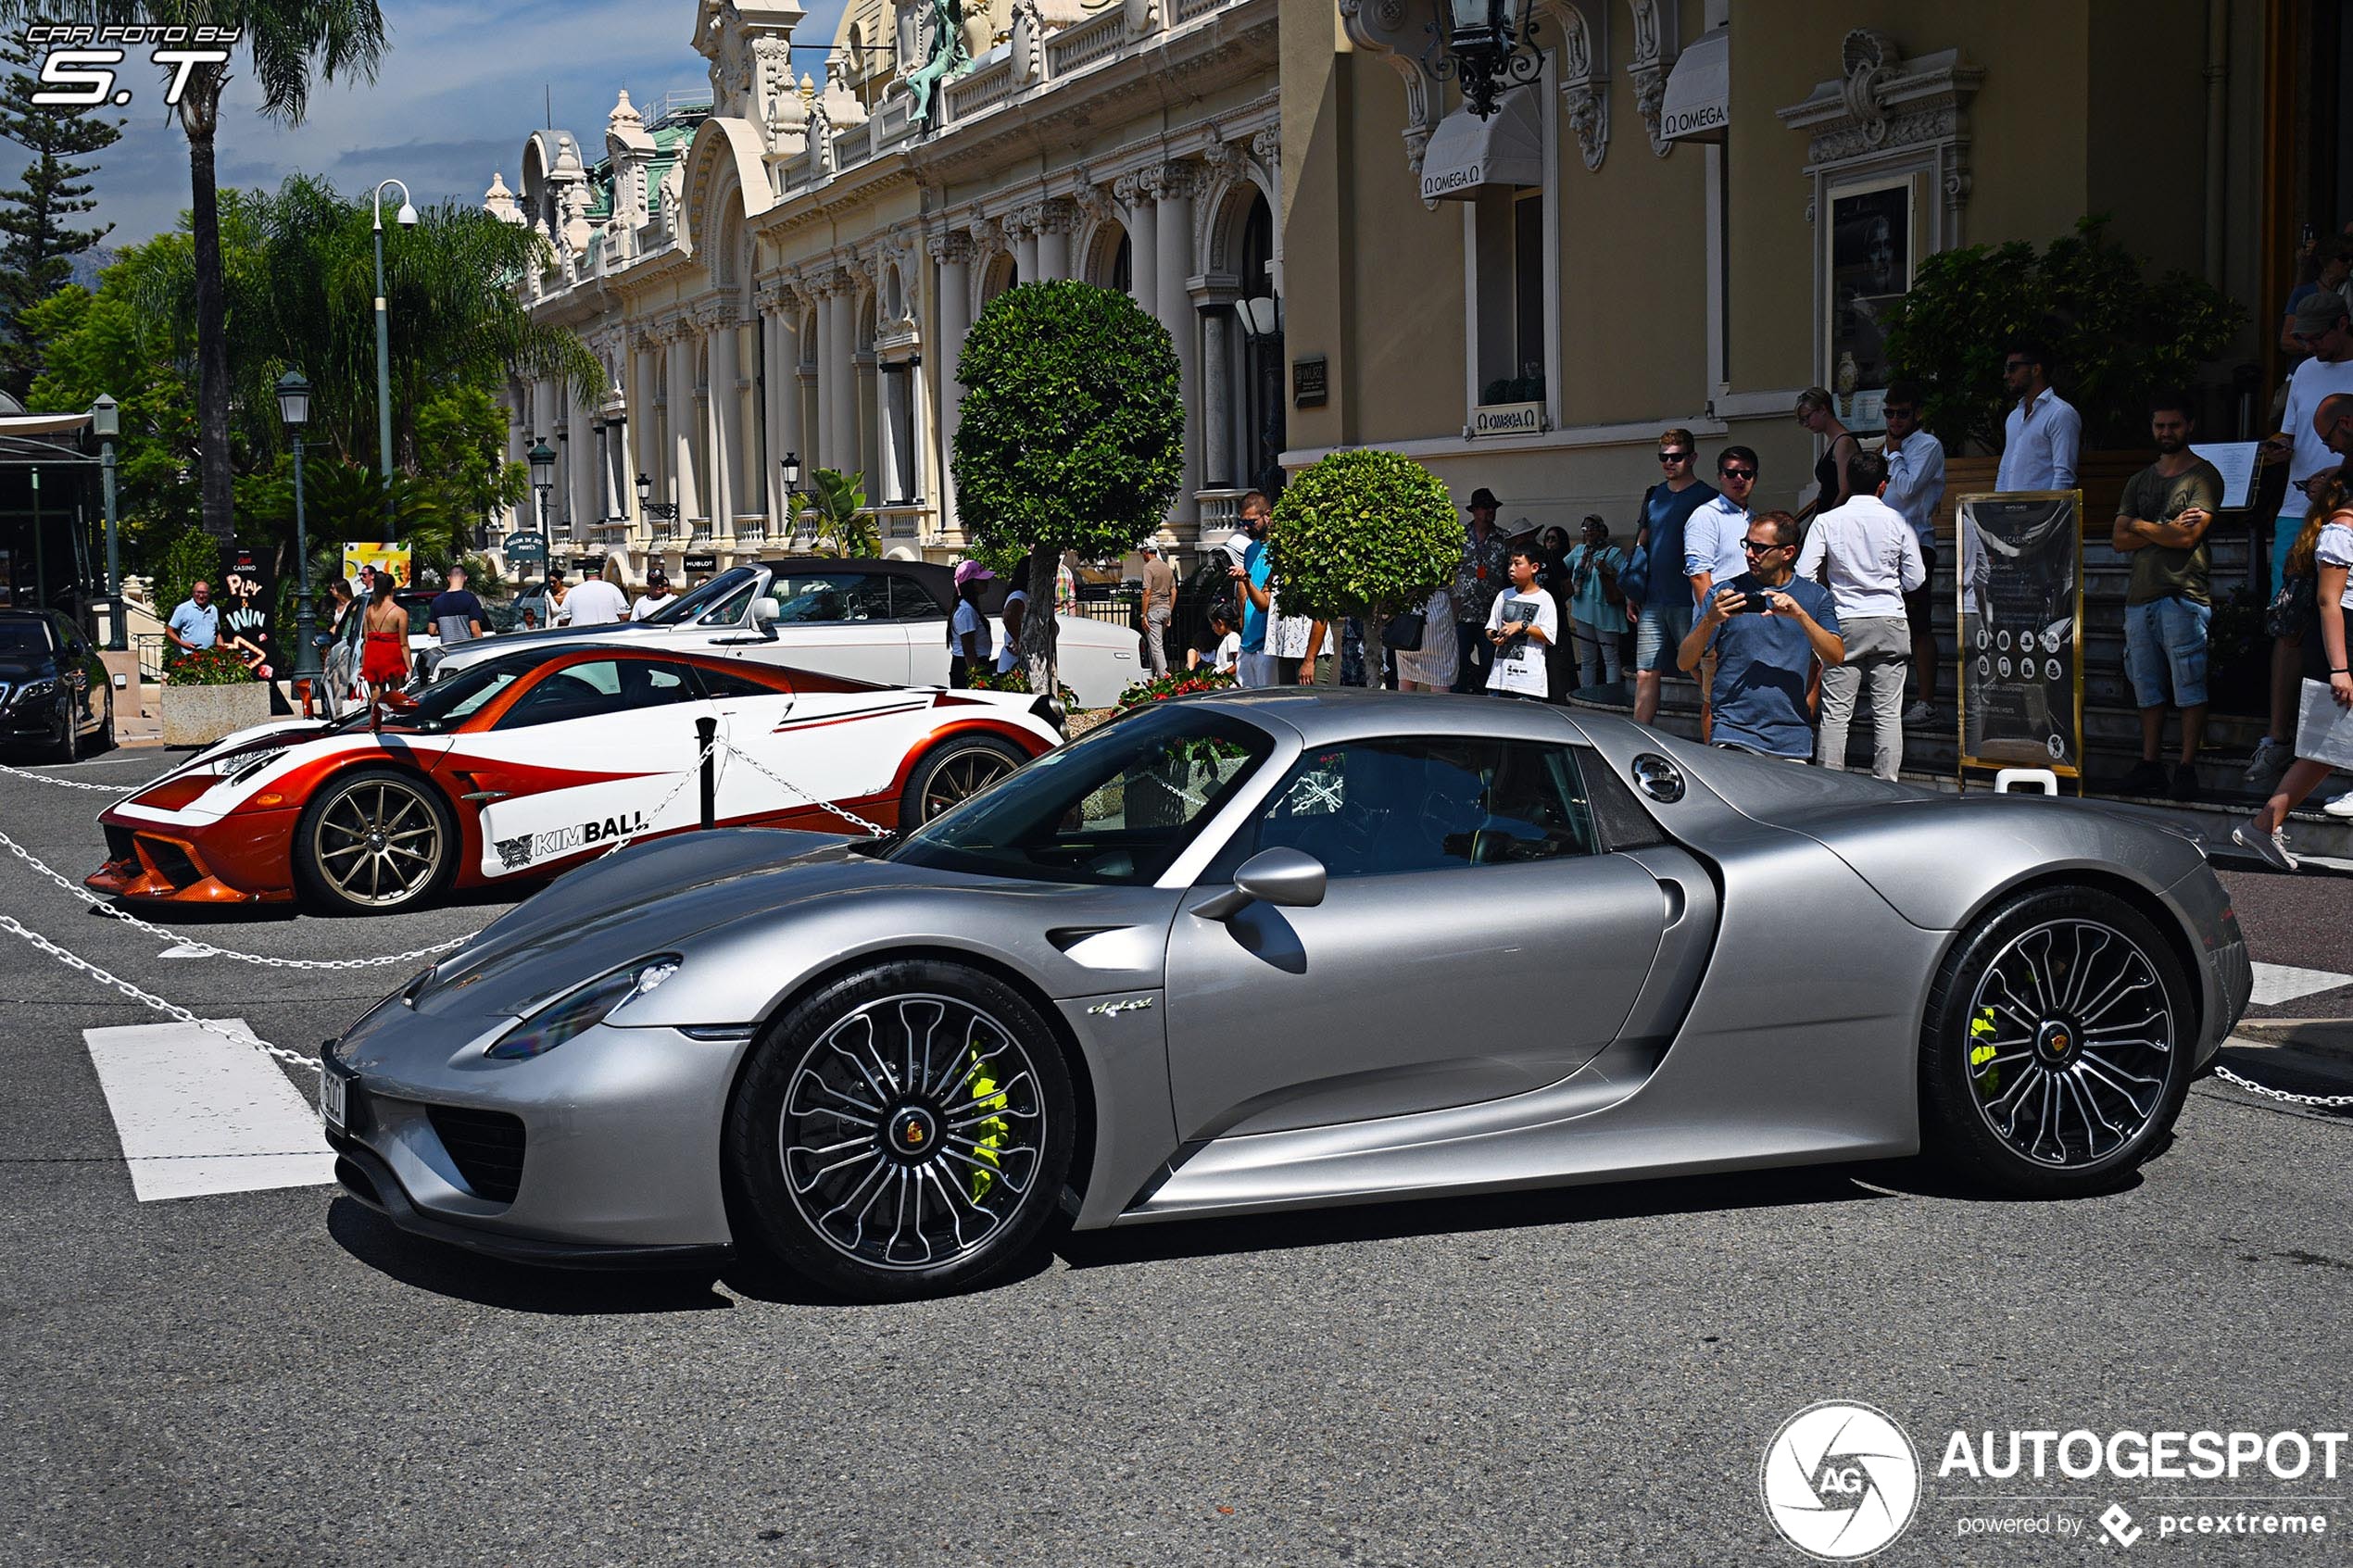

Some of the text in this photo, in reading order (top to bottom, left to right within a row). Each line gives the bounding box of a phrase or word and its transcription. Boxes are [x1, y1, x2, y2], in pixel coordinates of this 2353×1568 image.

[1679, 105, 1725, 132] OMEGA
[1434, 170, 1468, 192] OMEGA
[1489, 411, 1523, 430] OMEGA
[507, 537, 523, 546] SALON
[225, 573, 263, 597] PLAY
[225, 607, 266, 633] WIN
